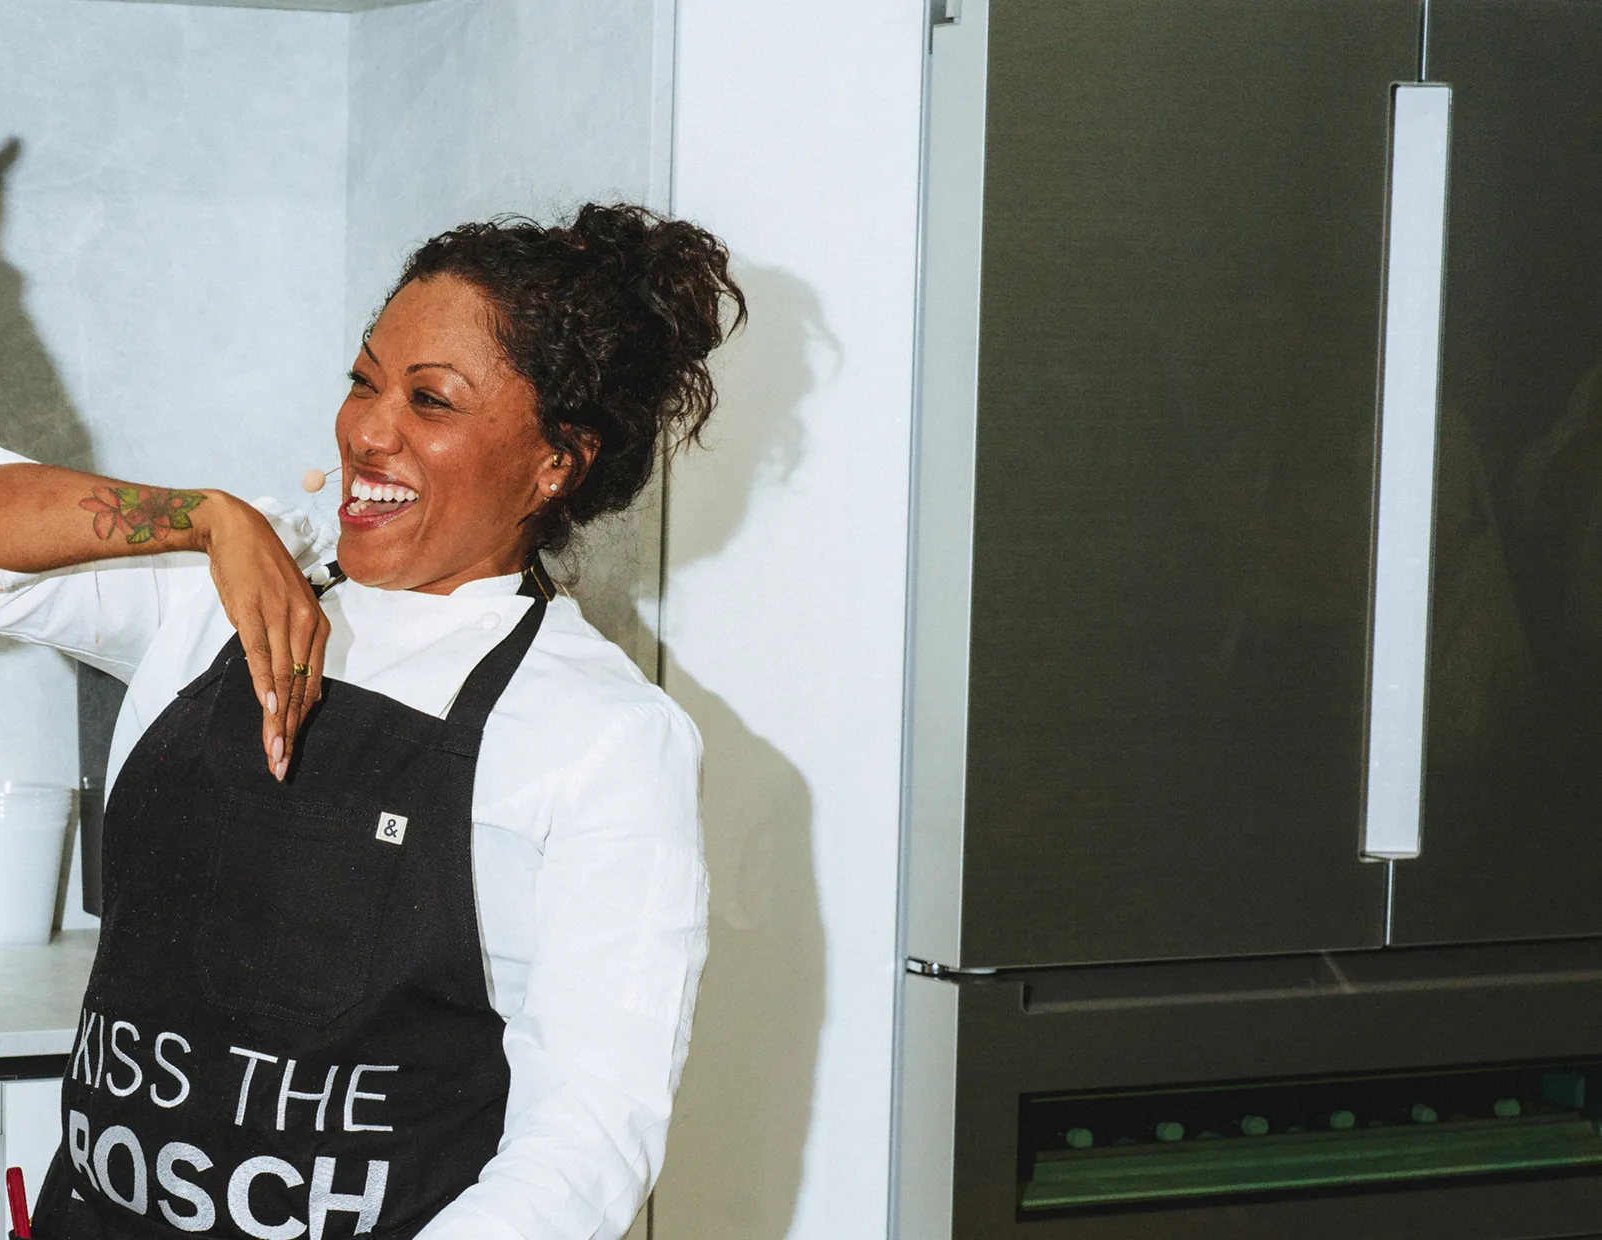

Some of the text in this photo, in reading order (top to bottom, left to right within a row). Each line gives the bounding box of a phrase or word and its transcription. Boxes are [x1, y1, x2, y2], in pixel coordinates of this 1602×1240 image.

[383, 818, 399, 838] &
[71, 1008, 400, 1133] KISS THE
[69, 1109, 390, 1240] BOSCH
